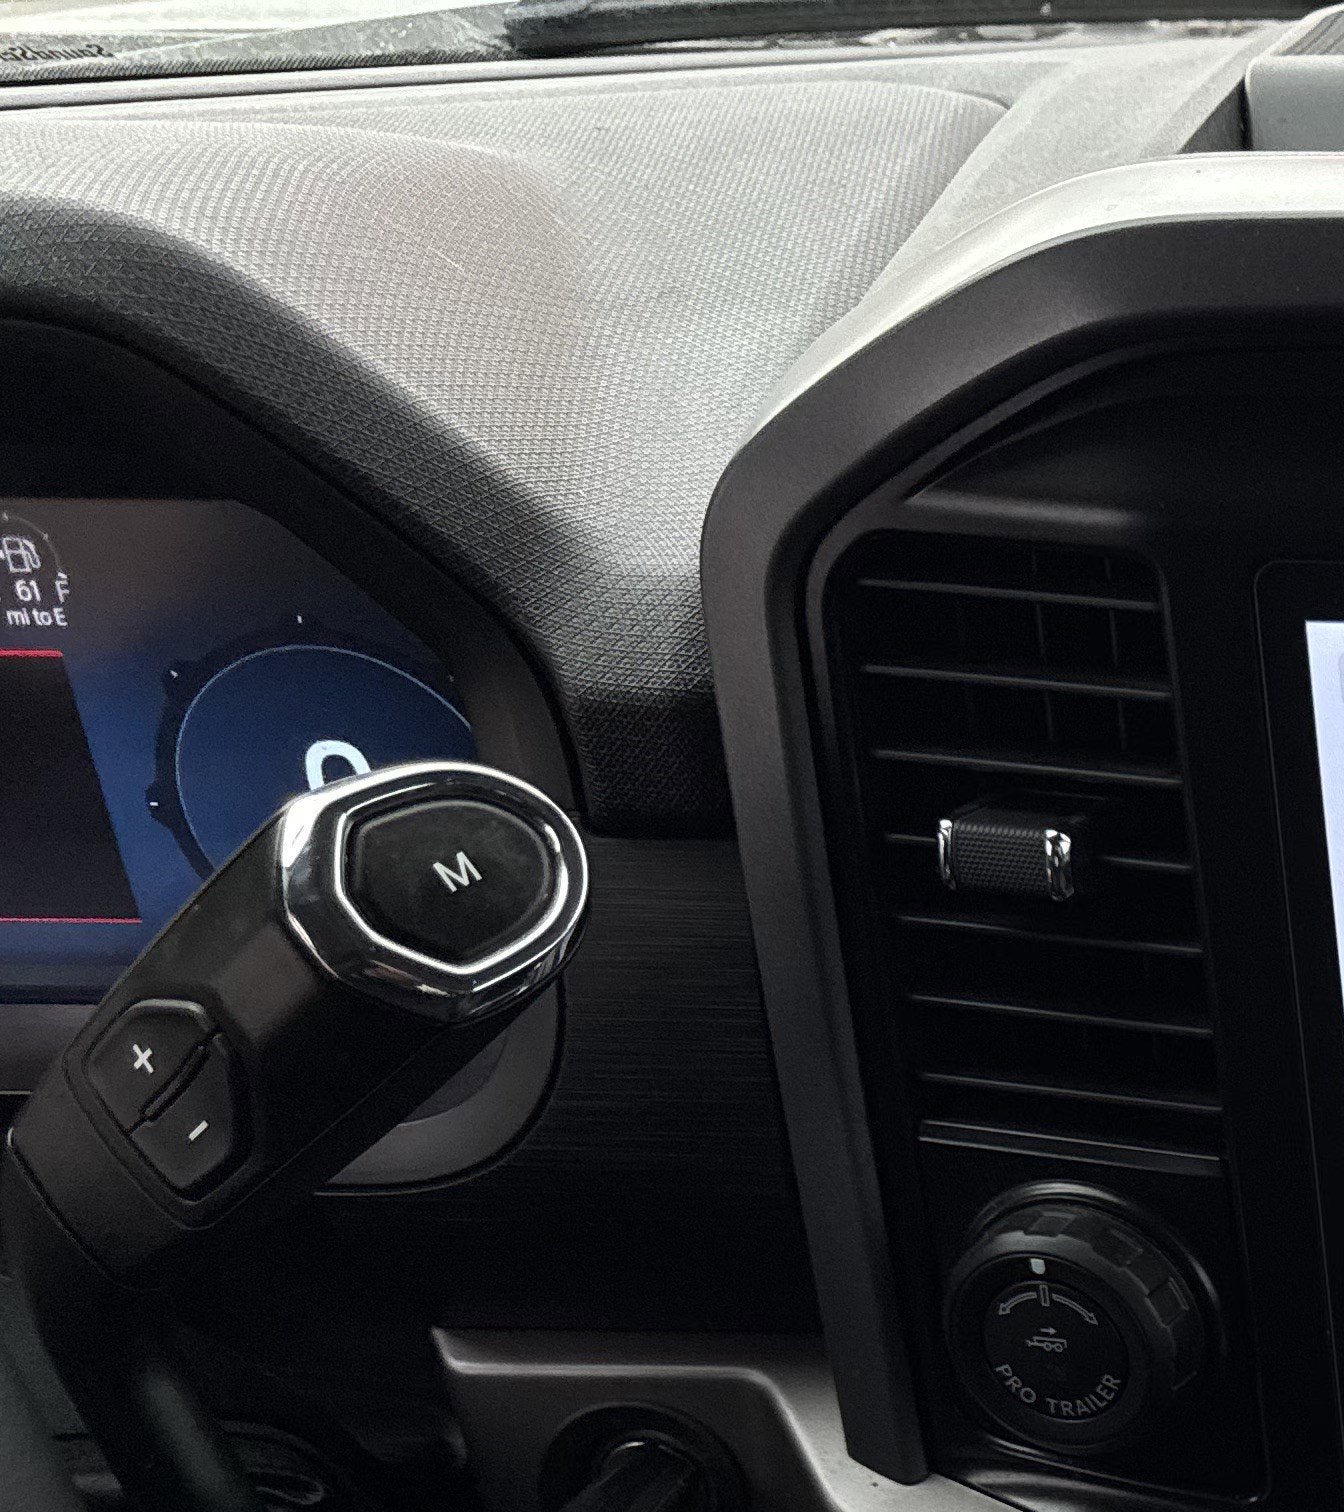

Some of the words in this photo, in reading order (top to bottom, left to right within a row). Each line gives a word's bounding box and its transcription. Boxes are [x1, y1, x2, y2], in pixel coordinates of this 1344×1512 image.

[15, 580, 41, 601] 61
[6, 607, 31, 626] mi
[32, 608, 52, 626] to
[53, 607, 68, 627] E
[432, 850, 483, 893] M
[995, 1364, 1037, 1404] PRO
[1046, 1373, 1122, 1417] TRAILER
